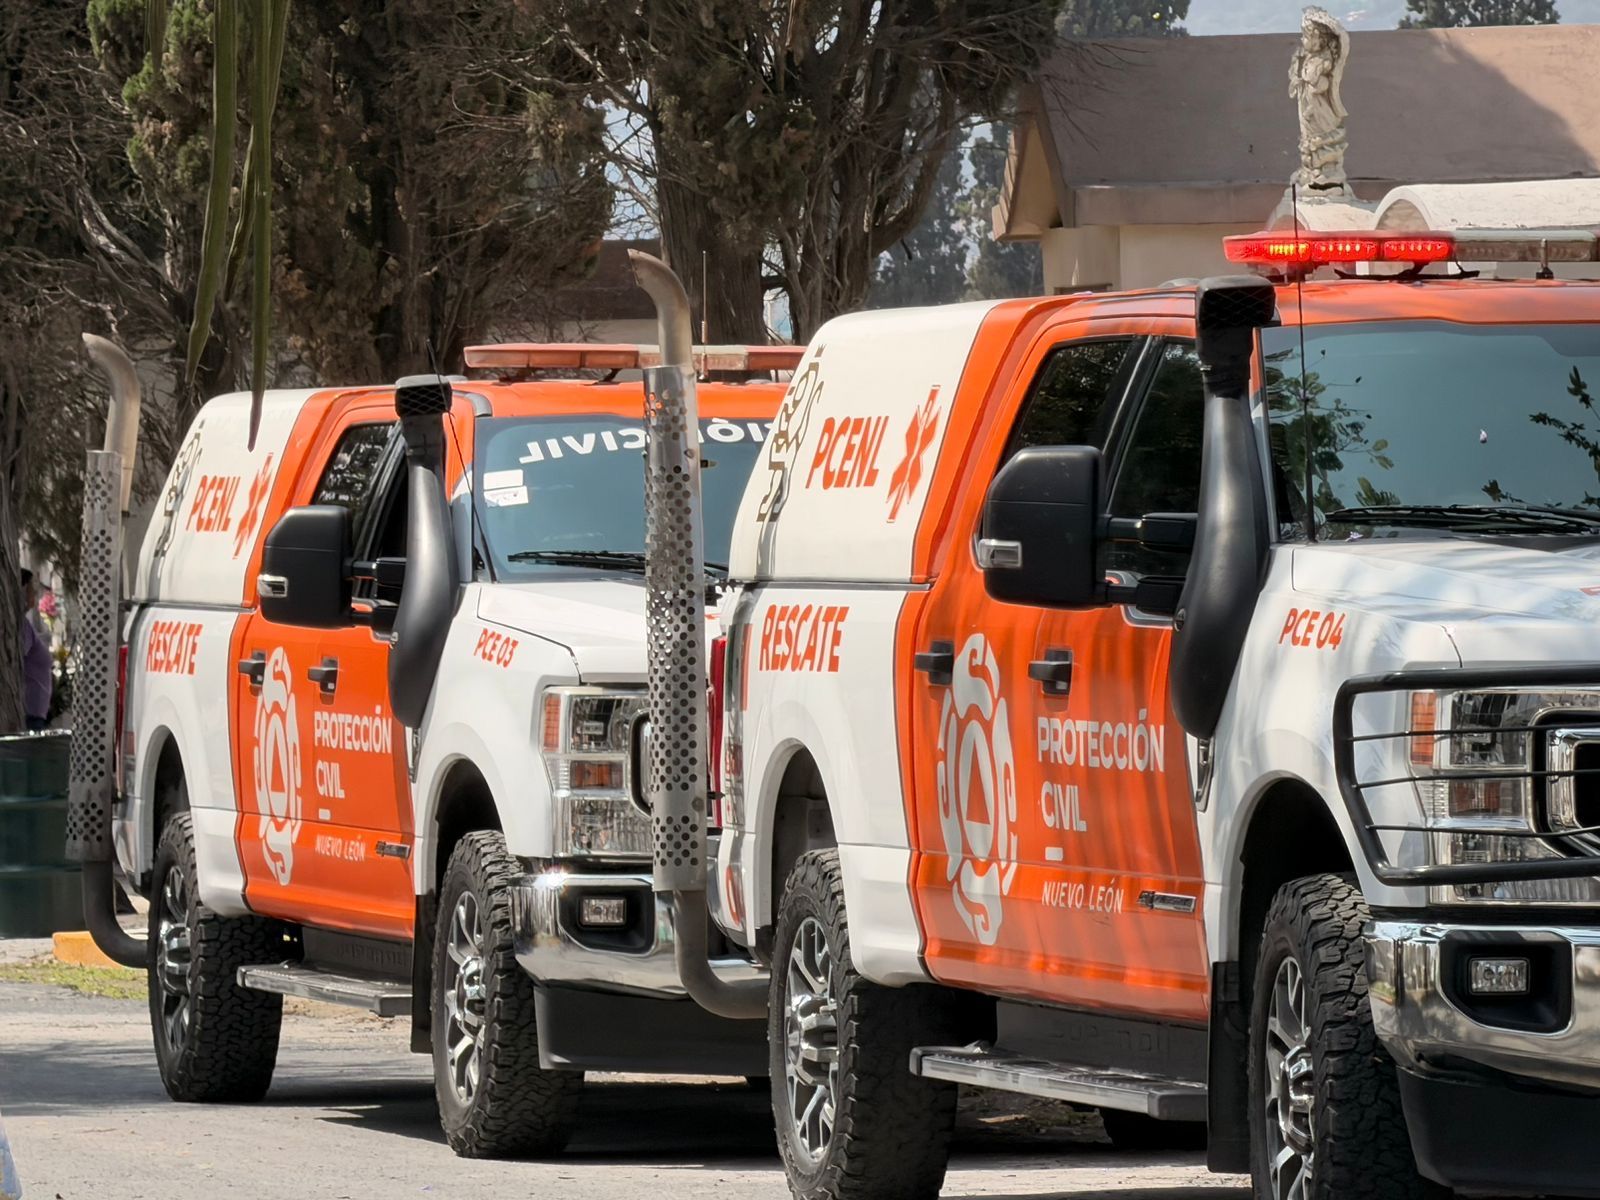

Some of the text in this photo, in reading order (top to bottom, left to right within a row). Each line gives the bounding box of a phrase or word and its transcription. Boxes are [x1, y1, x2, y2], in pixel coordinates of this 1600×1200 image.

[806, 416, 890, 490] PCENL
[186, 475, 241, 532] PCENL
[146, 621, 203, 675] RESCATE
[473, 628, 502, 661] PCE
[759, 604, 850, 672] RESCATE
[1279, 608, 1346, 650] PCE 04
[314, 705, 392, 753] PROTECCIÓN
[1038, 709, 1165, 772] PROTECCIÓN
[316, 760, 345, 798] CIVIL
[1041, 782, 1087, 832] CIVIL
[315, 835, 366, 861] NUEVO LEÓN
[1041, 879, 1125, 914] NUEVO LEÓN
